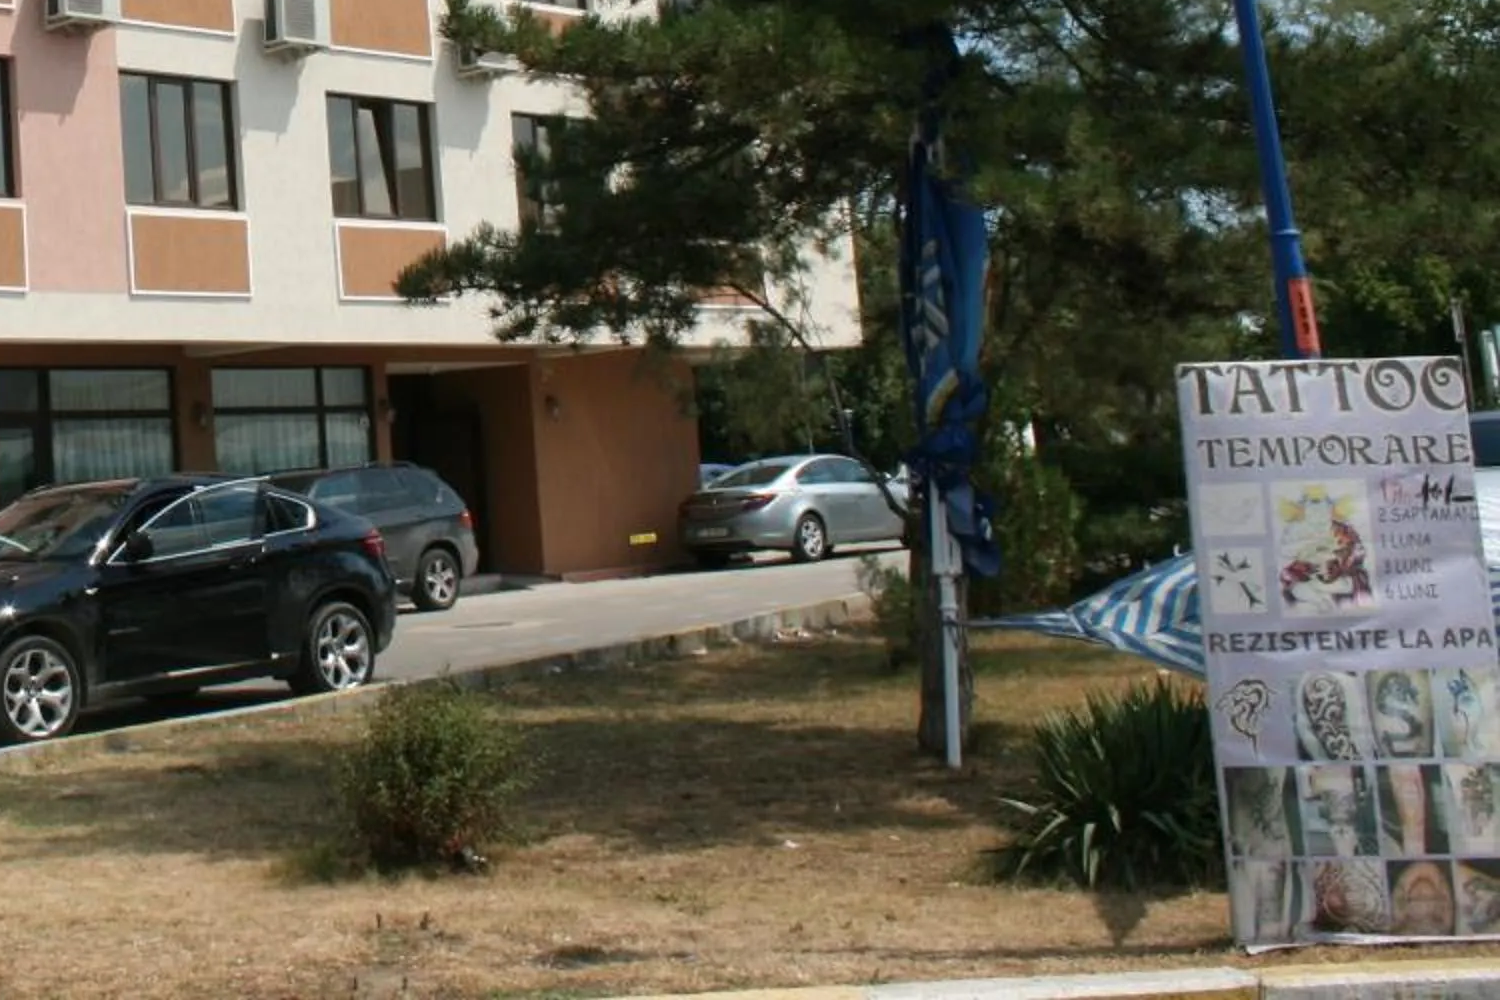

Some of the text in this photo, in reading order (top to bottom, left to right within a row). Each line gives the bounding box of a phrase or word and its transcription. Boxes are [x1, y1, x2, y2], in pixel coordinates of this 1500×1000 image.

[1180, 359, 1466, 415] TATTOO
[1197, 433, 1471, 468] TEMPORARE
[1208, 627, 1494, 653] REZISTENTE LA APA
